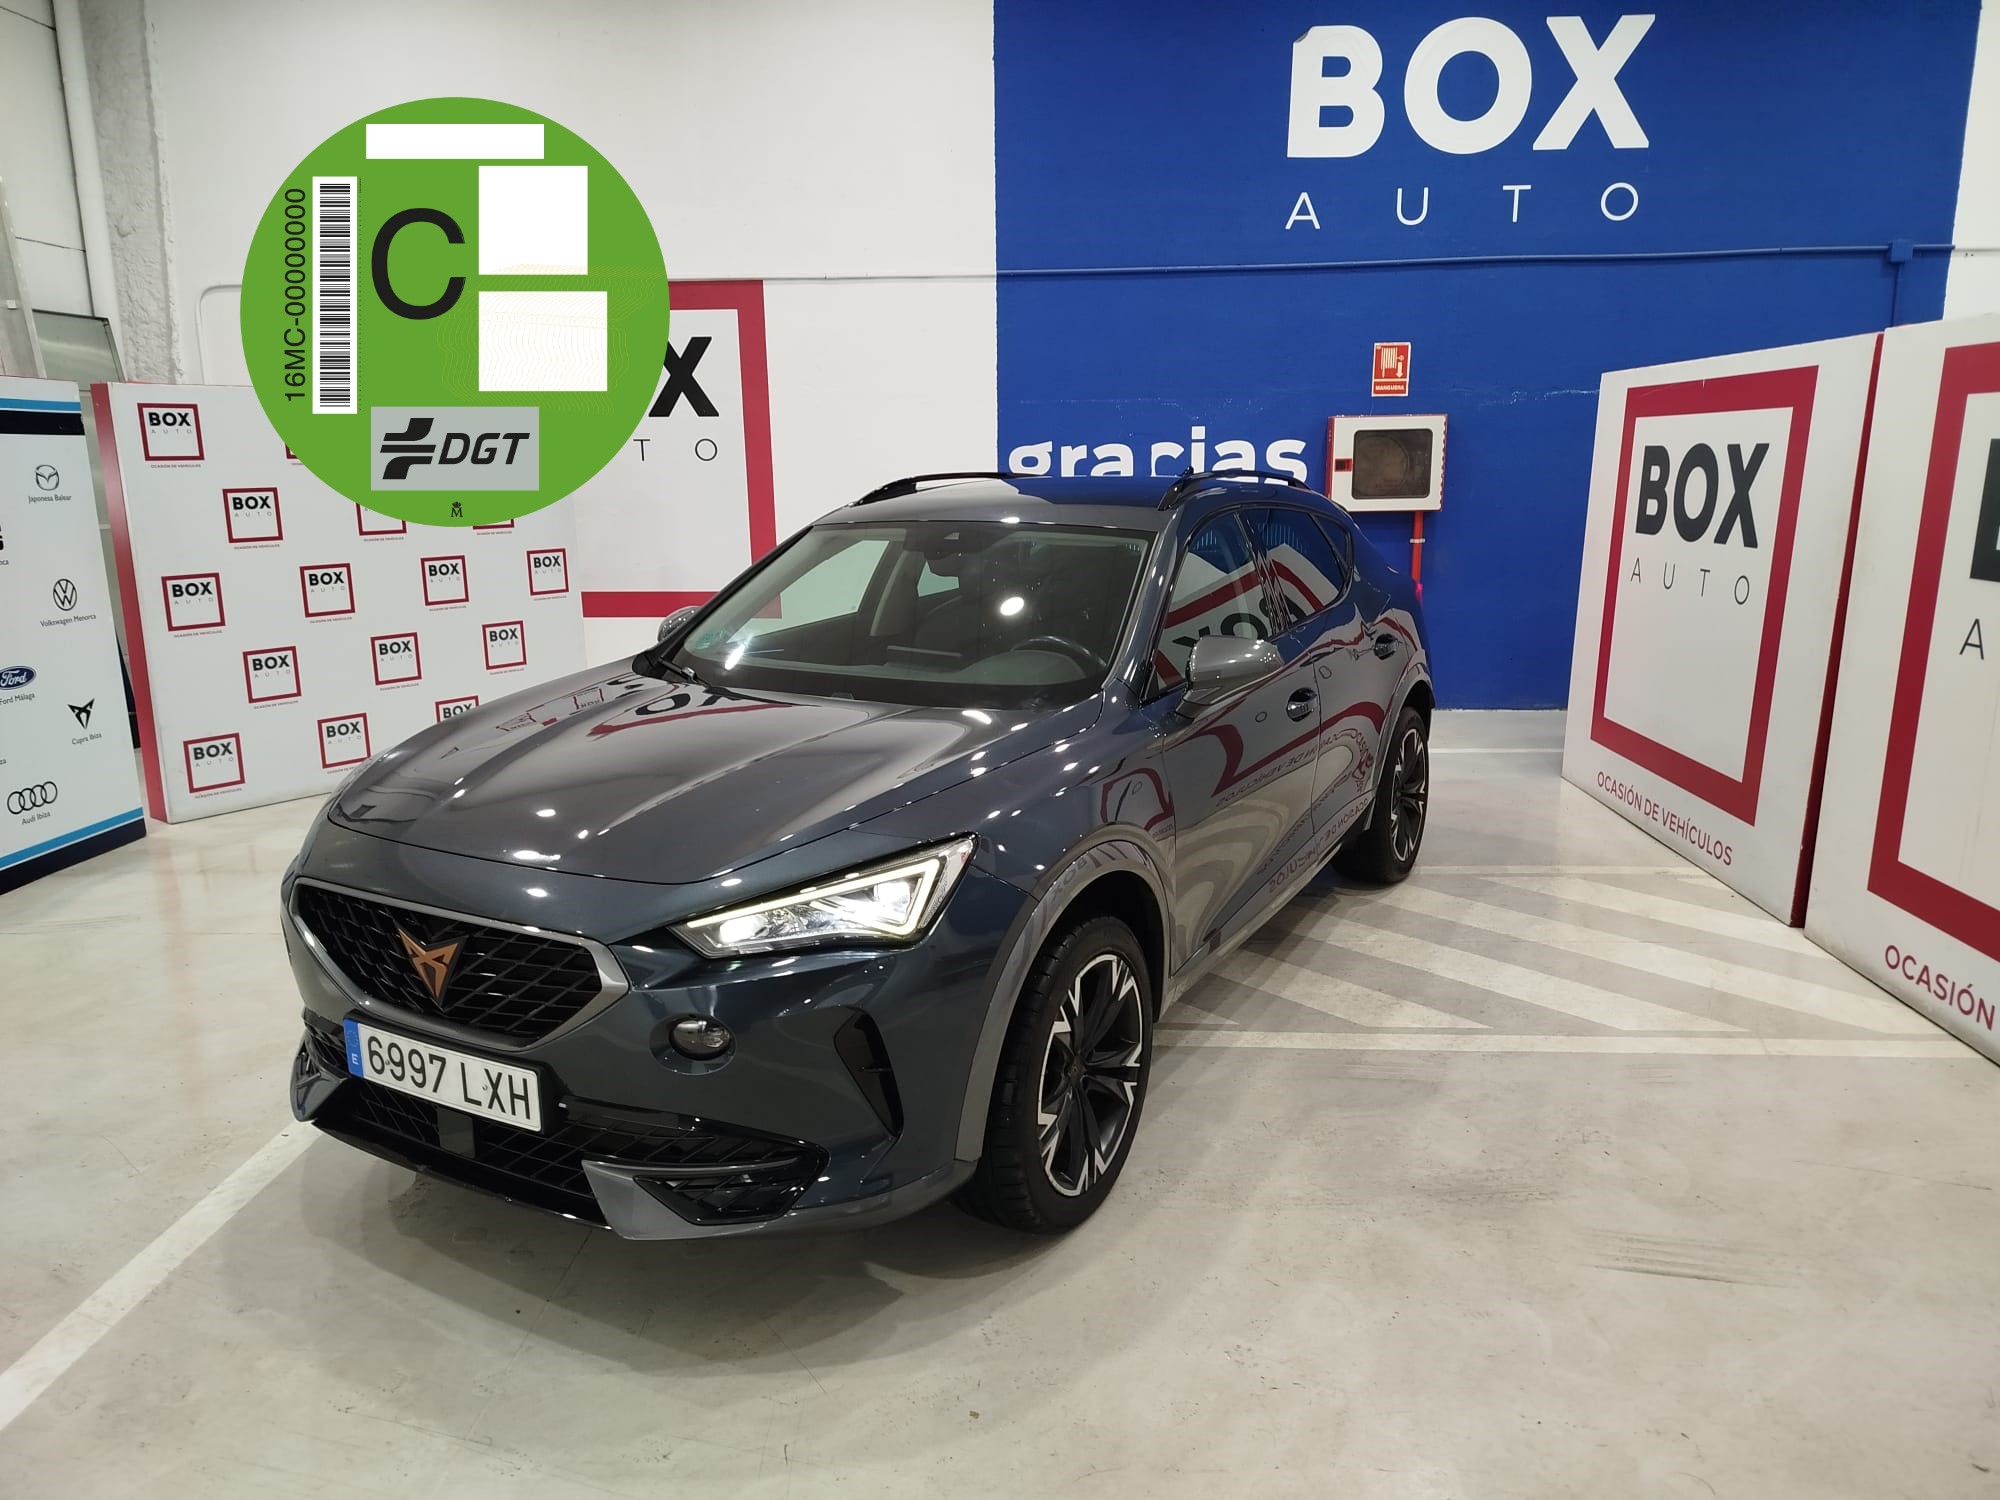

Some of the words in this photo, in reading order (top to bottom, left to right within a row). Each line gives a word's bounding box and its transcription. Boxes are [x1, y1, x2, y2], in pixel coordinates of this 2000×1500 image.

[1287, 14, 1656, 158] BOX
[1285, 182, 1640, 230] AUTO
[148, 412, 191, 427] BOX
[633, 438, 718, 462] TO
[1009, 425, 1308, 486] gracias
[232, 496, 271, 510] BOX
[1635, 443, 1770, 549] BOX
[533, 555, 561, 568] BOX
[429, 563, 459, 577] BOX
[309, 571, 344, 586] BOX
[1631, 557, 1750, 605] AUTO
[172, 582, 212, 598] BOX
[73, 613, 97, 622] Menorca
[489, 628, 518, 642] BOX
[379, 640, 412, 655] BOX
[252, 654, 290, 672] BOX
[1, 669, 27, 687] Ford
[14, 692, 35, 702] Málaga
[326, 721, 361, 738] BOX
[72, 736, 88, 745] Cupra
[89, 733, 102, 741] Ibiza
[193, 742, 233, 760] BOX
[22, 814, 36, 826] Audi
[37, 811, 51, 821] Ibiza
[1597, 771, 1643, 812] OCASIÓN
[1643, 798, 1660, 822] DE
[1661, 808, 1733, 866] VEHÍCULOS
[1885, 945, 1996, 1031] OCASIÓN
[352, 1053, 359, 1065] E
[368, 1036, 447, 1093] 6997
[460, 1062, 531, 1120] LXH
